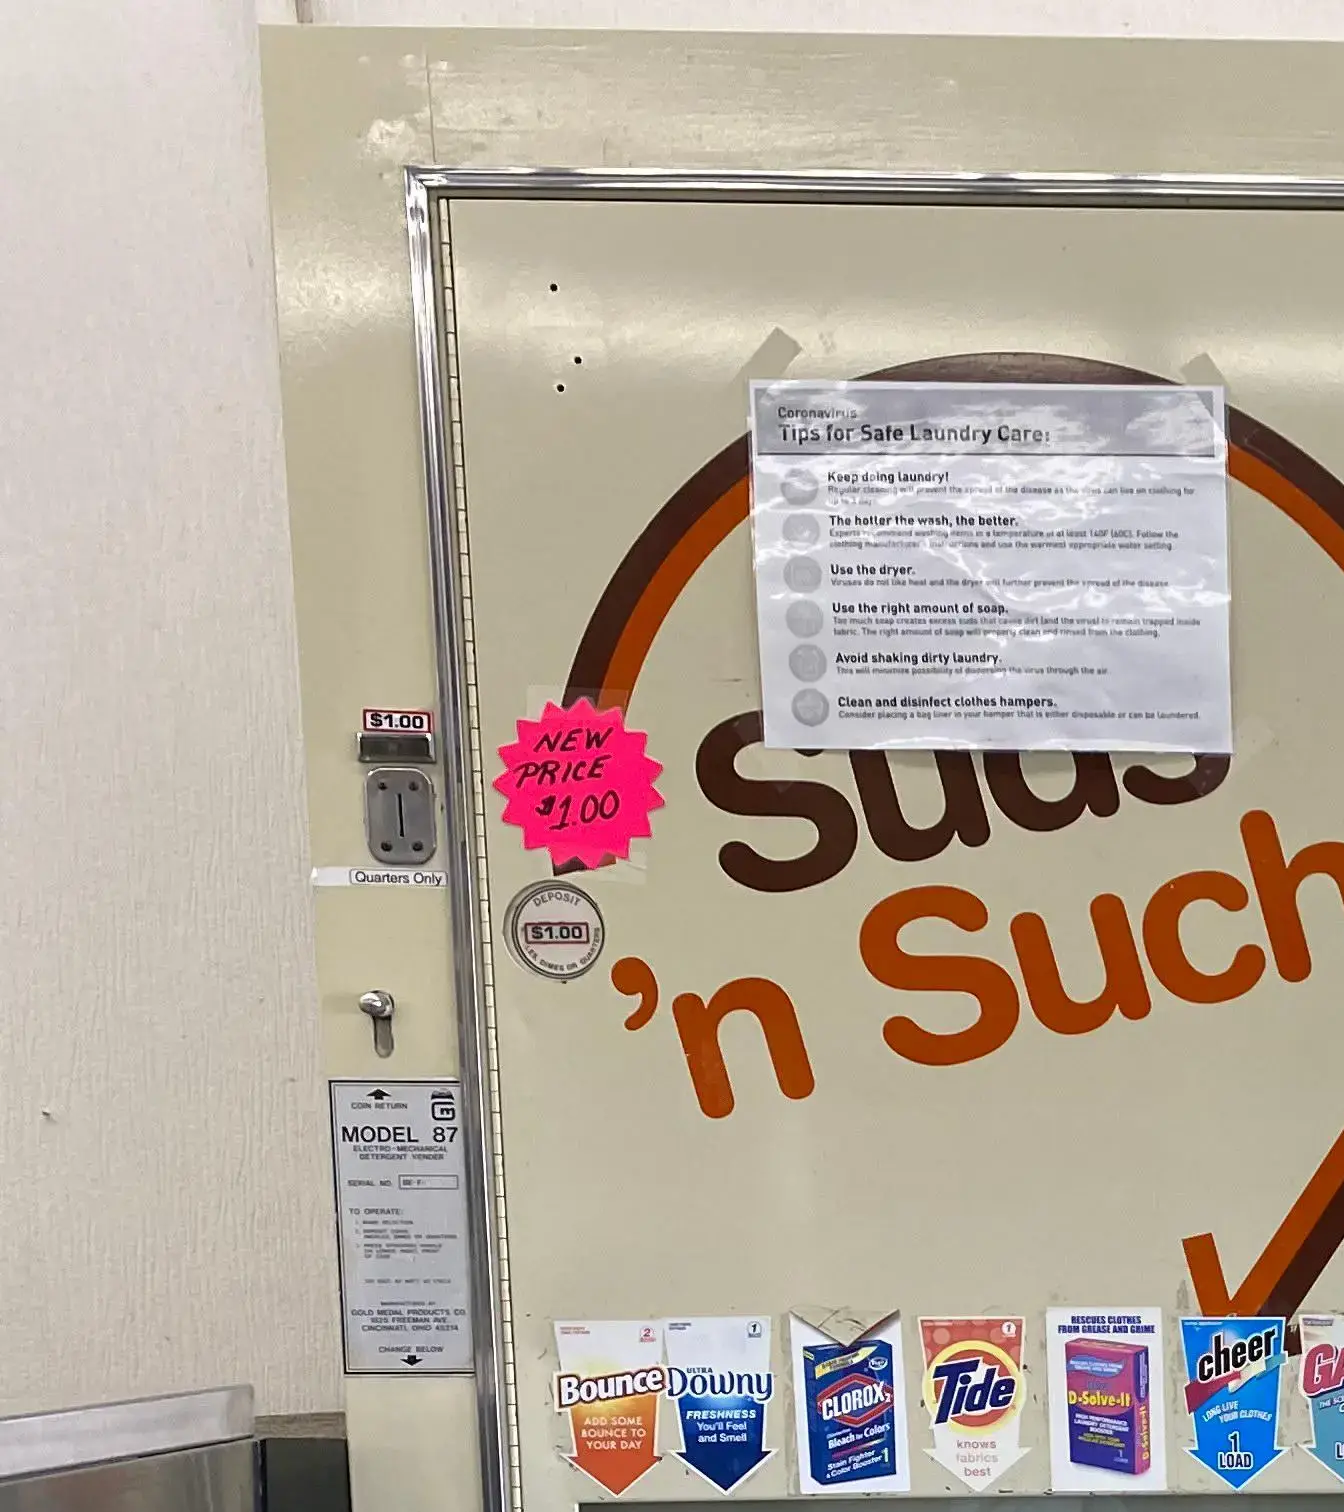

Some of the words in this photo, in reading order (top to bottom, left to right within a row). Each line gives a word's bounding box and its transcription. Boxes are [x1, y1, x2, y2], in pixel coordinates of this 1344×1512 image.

[778, 406, 858, 420] Coronavirus
[778, 424, 820, 446] Tips
[826, 424, 854, 442] for
[860, 424, 904, 442] Safe
[910, 424, 992, 446] Laundry
[998, 424, 1050, 442] Care:
[828, 472, 859, 484] Keep
[862, 472, 895, 484] doing
[898, 471, 950, 484] laundry!
[830, 516, 851, 526] The
[854, 516, 891, 526] hotter
[894, 516, 915, 526] the
[918, 516, 953, 527] wash,
[956, 516, 976, 526] the
[978, 516, 1019, 527] better.
[830, 564, 854, 575] Use
[856, 564, 876, 575] the
[879, 564, 916, 577] dryer.
[832, 603, 855, 614] Use
[858, 603, 878, 614] the
[881, 603, 910, 616] right
[914, 603, 959, 614] amount
[962, 603, 974, 614] of
[977, 605, 1009, 616] soap.
[836, 652, 868, 664] Avoid
[872, 652, 918, 666] shaking
[922, 652, 950, 666] dirty
[952, 652, 1002, 666] laundry.
[838, 696, 872, 708] Clean
[876, 696, 898, 708] and
[900, 696, 952, 708] disinfect
[954, 696, 996, 708] clothes
[1000, 696, 1058, 709] hampers.
[370, 713, 424, 730] $1.00
[534, 728, 614, 754] NEW
[515, 755, 613, 789] PRICE
[536, 790, 620, 832] $1.00
[354, 872, 410, 885] Quarters
[412, 872, 443, 887] Only
[532, 891, 582, 907] DEPOSIT
[531, 926, 583, 940] $1.00
[342, 1126, 419, 1143] MODEL
[432, 1126, 458, 1143] 87
[1198, 1326, 1278, 1382] cheer
[560, 1368, 664, 1406] Bounce
[666, 1367, 773, 1401] Downy
[932, 1358, 1016, 1424] Tide
[686, 1410, 757, 1420] FRESHNESS
[1218, 1453, 1252, 1468] LOAD
[964, 1467, 992, 1477] best
